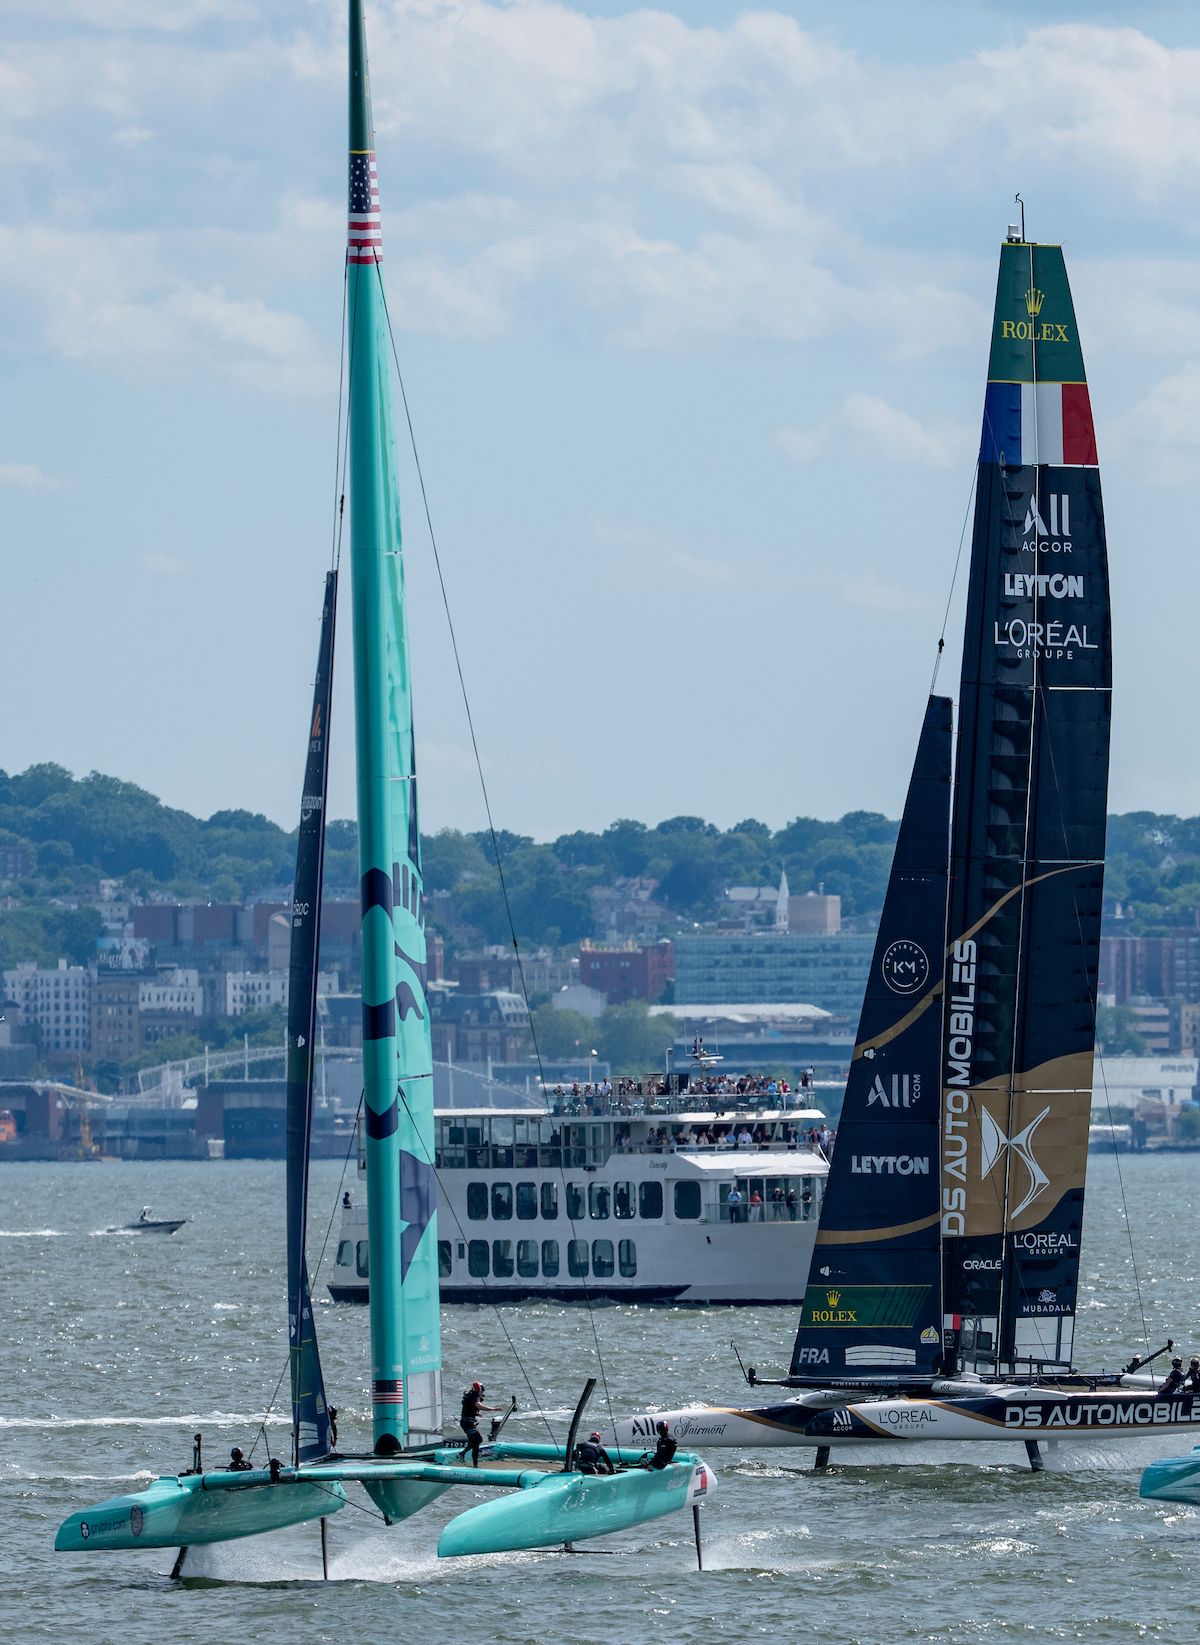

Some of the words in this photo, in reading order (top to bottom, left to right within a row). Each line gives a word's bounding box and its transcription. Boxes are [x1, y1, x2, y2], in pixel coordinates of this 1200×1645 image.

[1001, 320, 1069, 342] ROLEX
[1021, 540, 1073, 553] ACCOR
[1004, 573, 1084, 599] LEYTON
[994, 618, 1098, 648] L'ORÉAL
[1017, 649, 1073, 660] GROUPE
[893, 961, 916, 974] KM
[944, 939, 978, 1182] AUTOMOBILES
[851, 1155, 929, 1176] LEYTON
[942, 1188, 966, 1236] DS
[1013, 1232, 1078, 1249] L'ORÉAL
[963, 1259, 1002, 1270] ORACLE
[812, 1310, 857, 1322] ROLEX
[1023, 1304, 1072, 1313] MUBADALA
[798, 1348, 830, 1364] FRA
[879, 1408, 938, 1424] L'ORÉAL
[1005, 1406, 1042, 1428] DS
[673, 1415, 728, 1439] Fairmont
[91, 1519, 126, 1535] crypto.com
